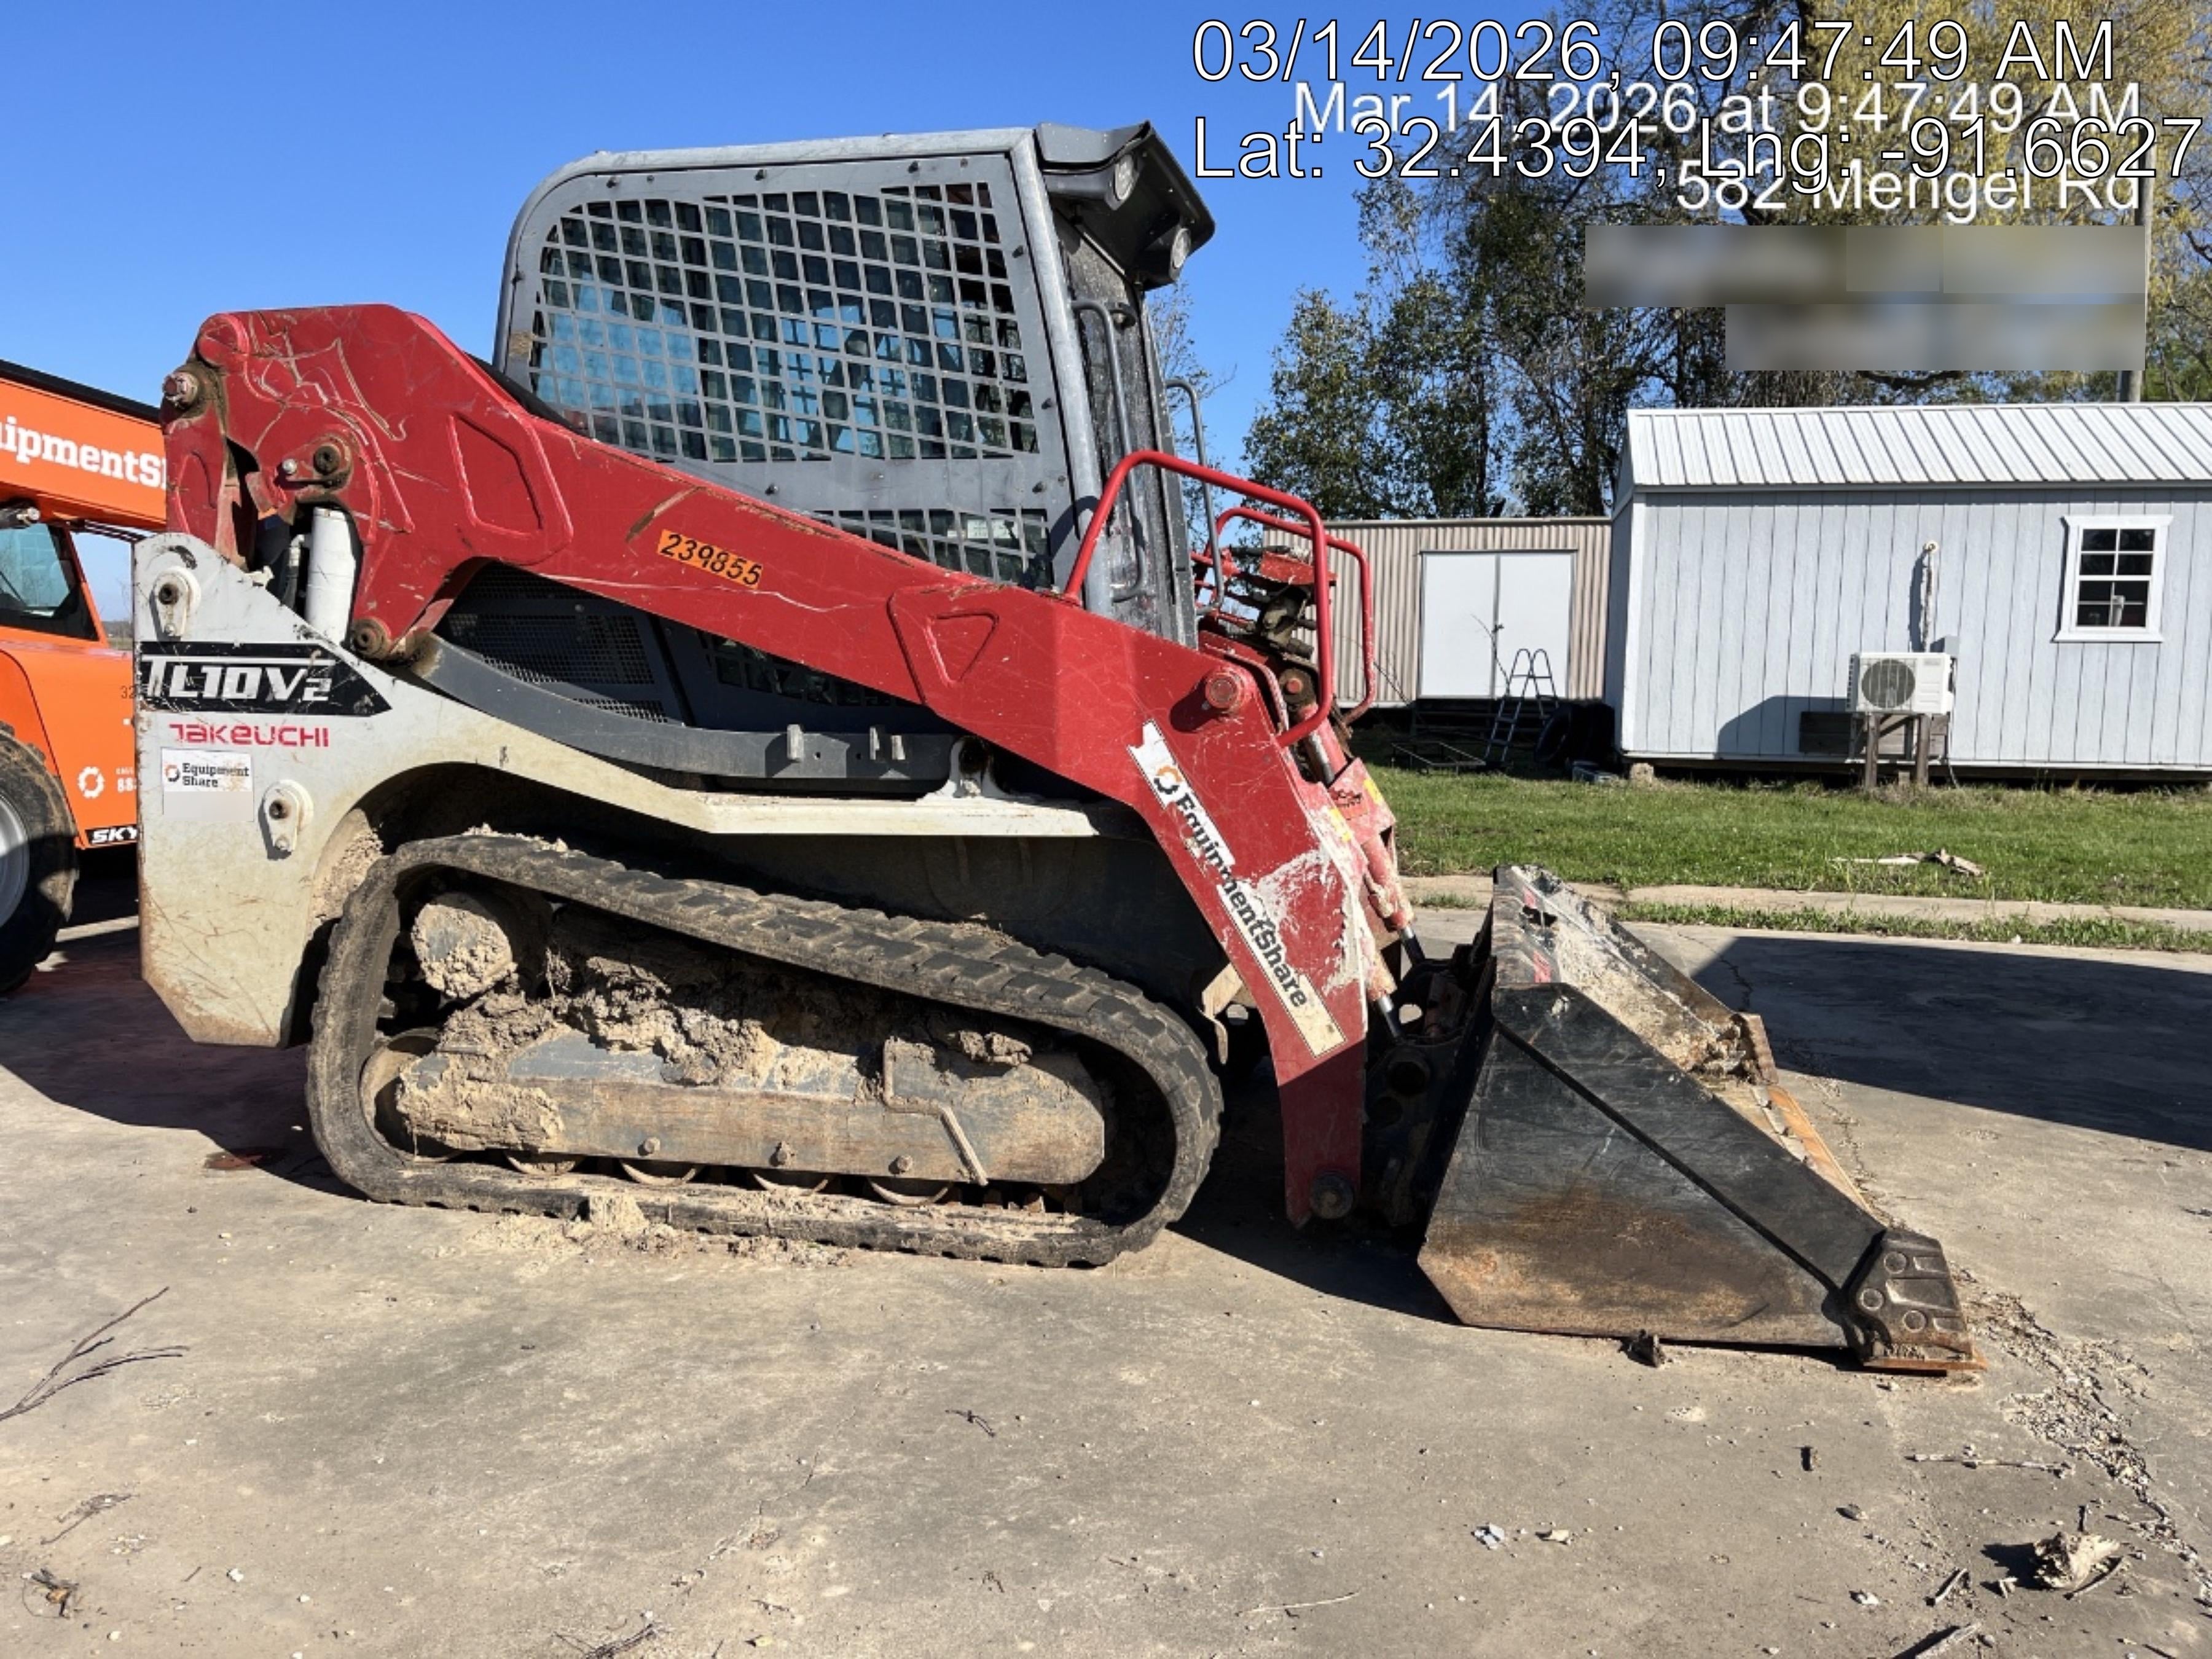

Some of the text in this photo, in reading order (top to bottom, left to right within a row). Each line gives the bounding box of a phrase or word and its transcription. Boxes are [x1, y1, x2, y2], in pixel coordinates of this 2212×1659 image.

[0, 415, 167, 490] ipmentS
[660, 534, 762, 585] 239855
[182, 776, 218, 787] Share
